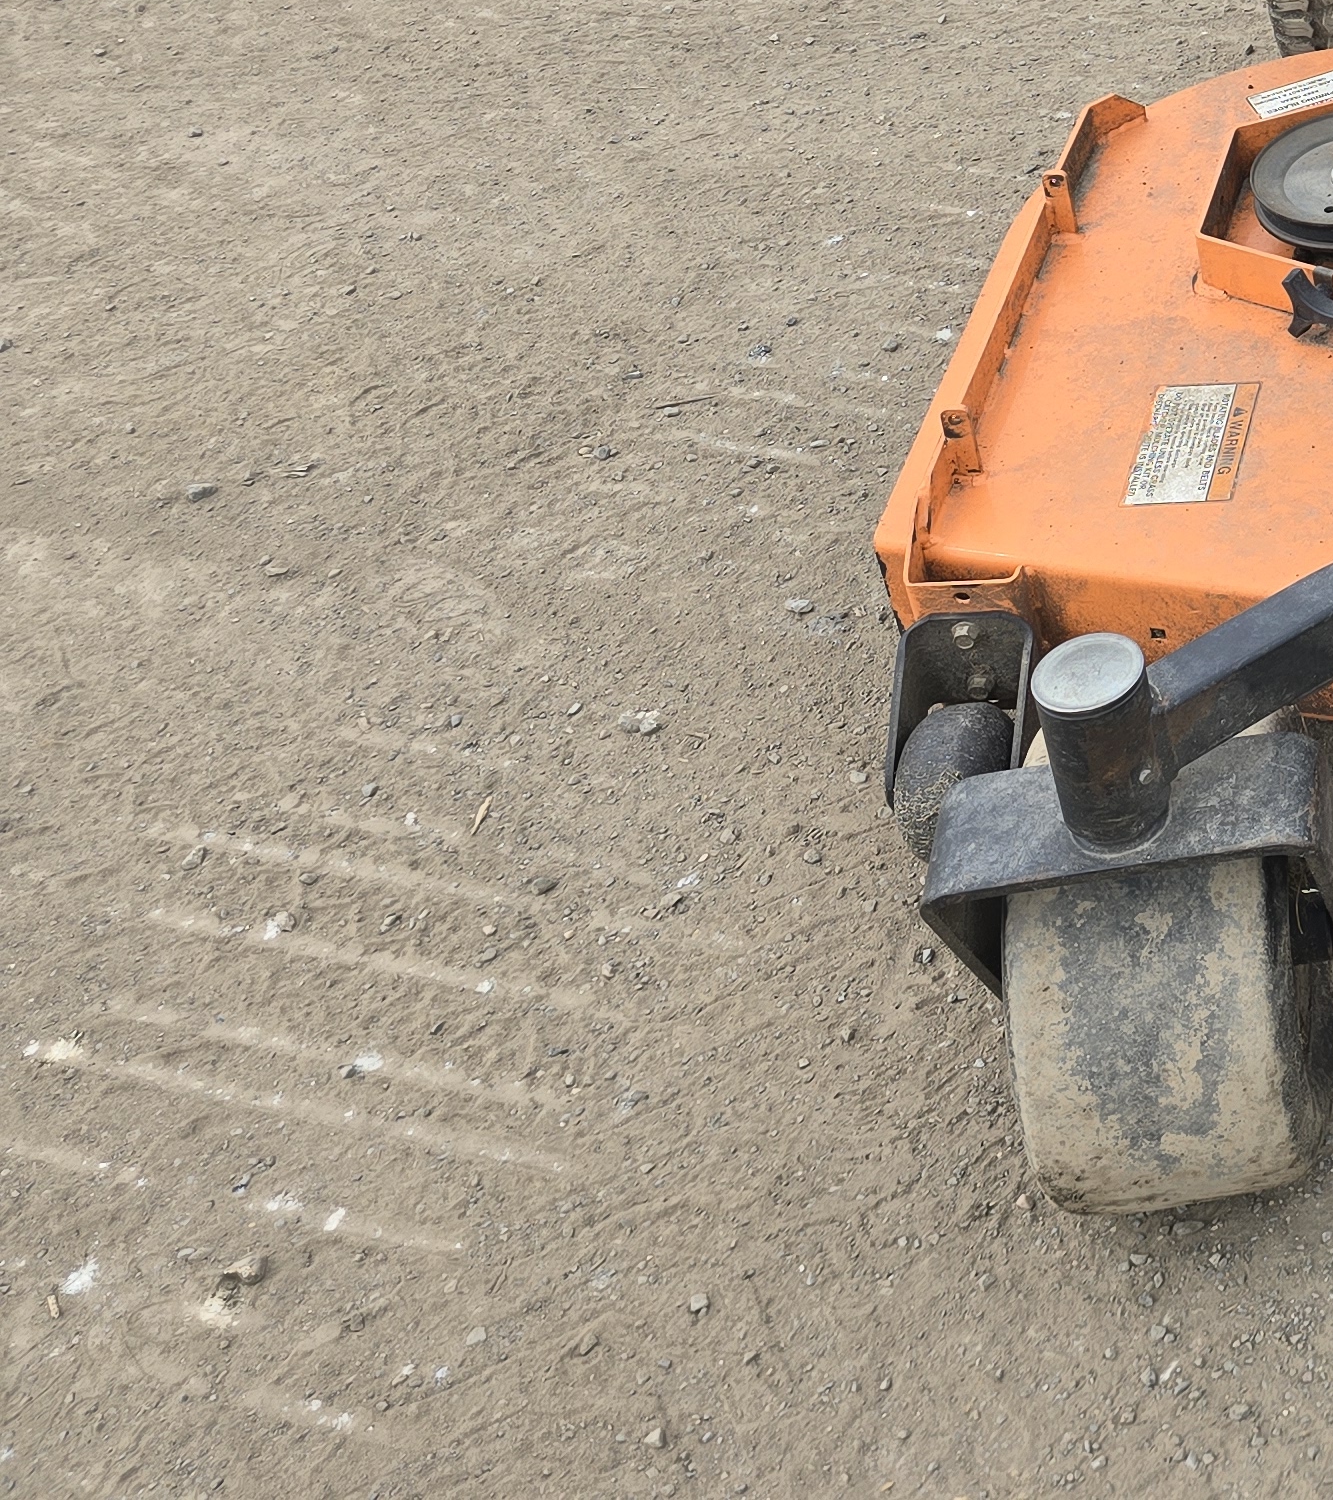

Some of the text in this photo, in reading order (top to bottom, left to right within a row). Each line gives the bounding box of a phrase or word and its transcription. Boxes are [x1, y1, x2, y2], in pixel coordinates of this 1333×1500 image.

[1216, 420, 1243, 474] WARNING
[1203, 454, 1214, 468] AND
[1141, 467, 1152, 478] KIT
[1197, 470, 1210, 490] BELTS
